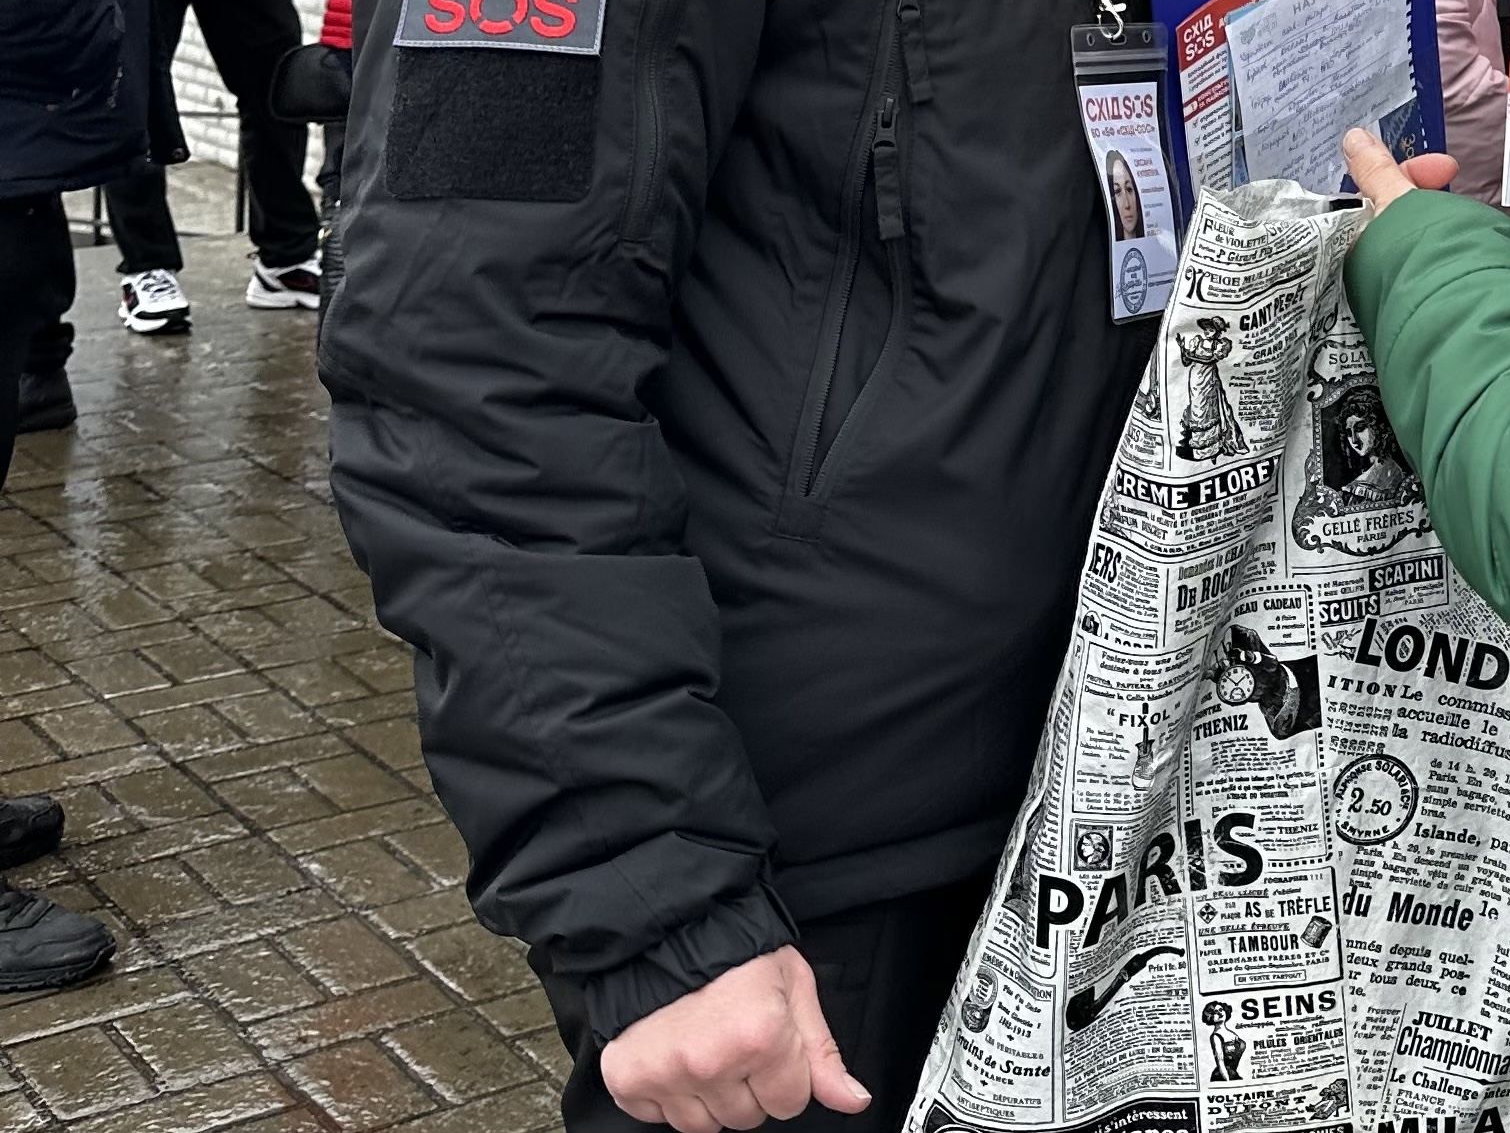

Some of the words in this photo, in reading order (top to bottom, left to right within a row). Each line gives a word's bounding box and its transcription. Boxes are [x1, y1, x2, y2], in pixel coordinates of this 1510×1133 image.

[1184, 14, 1213, 43] СХІД
[1186, 30, 1215, 61] SOS
[1086, 97, 1122, 122] СХІД
[1123, 94, 1153, 119] SOS
[1203, 218, 1235, 236] FLEUR
[1226, 235, 1266, 248] VIOLETTE
[1240, 304, 1272, 330] GANT
[1253, 342, 1282, 359] GRAND
[1365, 510, 1415, 532] FRÈRES
[1356, 532, 1386, 543] PARIS
[1374, 558, 1441, 588] SCAPINI
[1264, 597, 1301, 610] CADEAU
[1327, 675, 1397, 698] ITION
[1400, 685, 1423, 701] Le
[1119, 709, 1170, 727] FIXOL
[1193, 714, 1248, 741] THENIZ
[1397, 706, 1470, 730] accueille
[1482, 720, 1498, 736] le
[1392, 723, 1409, 739] la
[1430, 758, 1443, 768] de
[1448, 762, 1460, 771] 14
[1428, 771, 1458, 784] Paris.
[1467, 776, 1482, 787] En
[1347, 787, 1391, 815] 2.50
[1423, 795, 1457, 809] simple
[1426, 784, 1449, 796] sans
[1457, 787, 1498, 807] bagage,
[1421, 807, 1447, 819] bras.
[1340, 820, 1389, 837] SMYRNE
[1414, 823, 1481, 846] Islande,
[1356, 845, 1384, 858] Paris.
[1392, 851, 1407, 862] En
[1414, 856, 1452, 869] descend
[1440, 849, 1479, 862] premier
[1483, 855, 1508, 870] train
[1036, 812, 1263, 949] PARIS
[1353, 857, 1375, 867] sans
[1382, 860, 1420, 876] bagage,
[1427, 867, 1448, 879] vêtu
[1471, 874, 1494, 889] gris,
[1351, 868, 1383, 881] simple
[1389, 874, 1432, 889] serviette
[1479, 888, 1502, 902] sous
[1245, 902, 1262, 918] AS
[1278, 895, 1332, 917] TRÈFLE
[1343, 885, 1372, 917] du
[1387, 892, 1474, 931] Monde
[1479, 901, 1500, 921] le
[1228, 934, 1299, 953] TAMBOUR
[1389, 944, 1432, 958] depuis
[1439, 951, 1474, 966] quel-
[1347, 953, 1379, 968] deux
[1385, 959, 1432, 974] grands
[1441, 967, 1471, 981] pos-
[1370, 973, 1397, 986] tous
[1405, 975, 1441, 994] deux,
[1451, 985, 1467, 996] ce
[1241, 990, 1337, 1020] SEINS
[1412, 1011, 1493, 1042] JUILLET
[984, 1056, 996, 1069] de
[1390, 1068, 1406, 1083] Le
[1412, 1070, 1479, 1101] Challenge
[1207, 1090, 1274, 1103] VOLTAIRE
[1397, 1089, 1445, 1106] FRANCE
